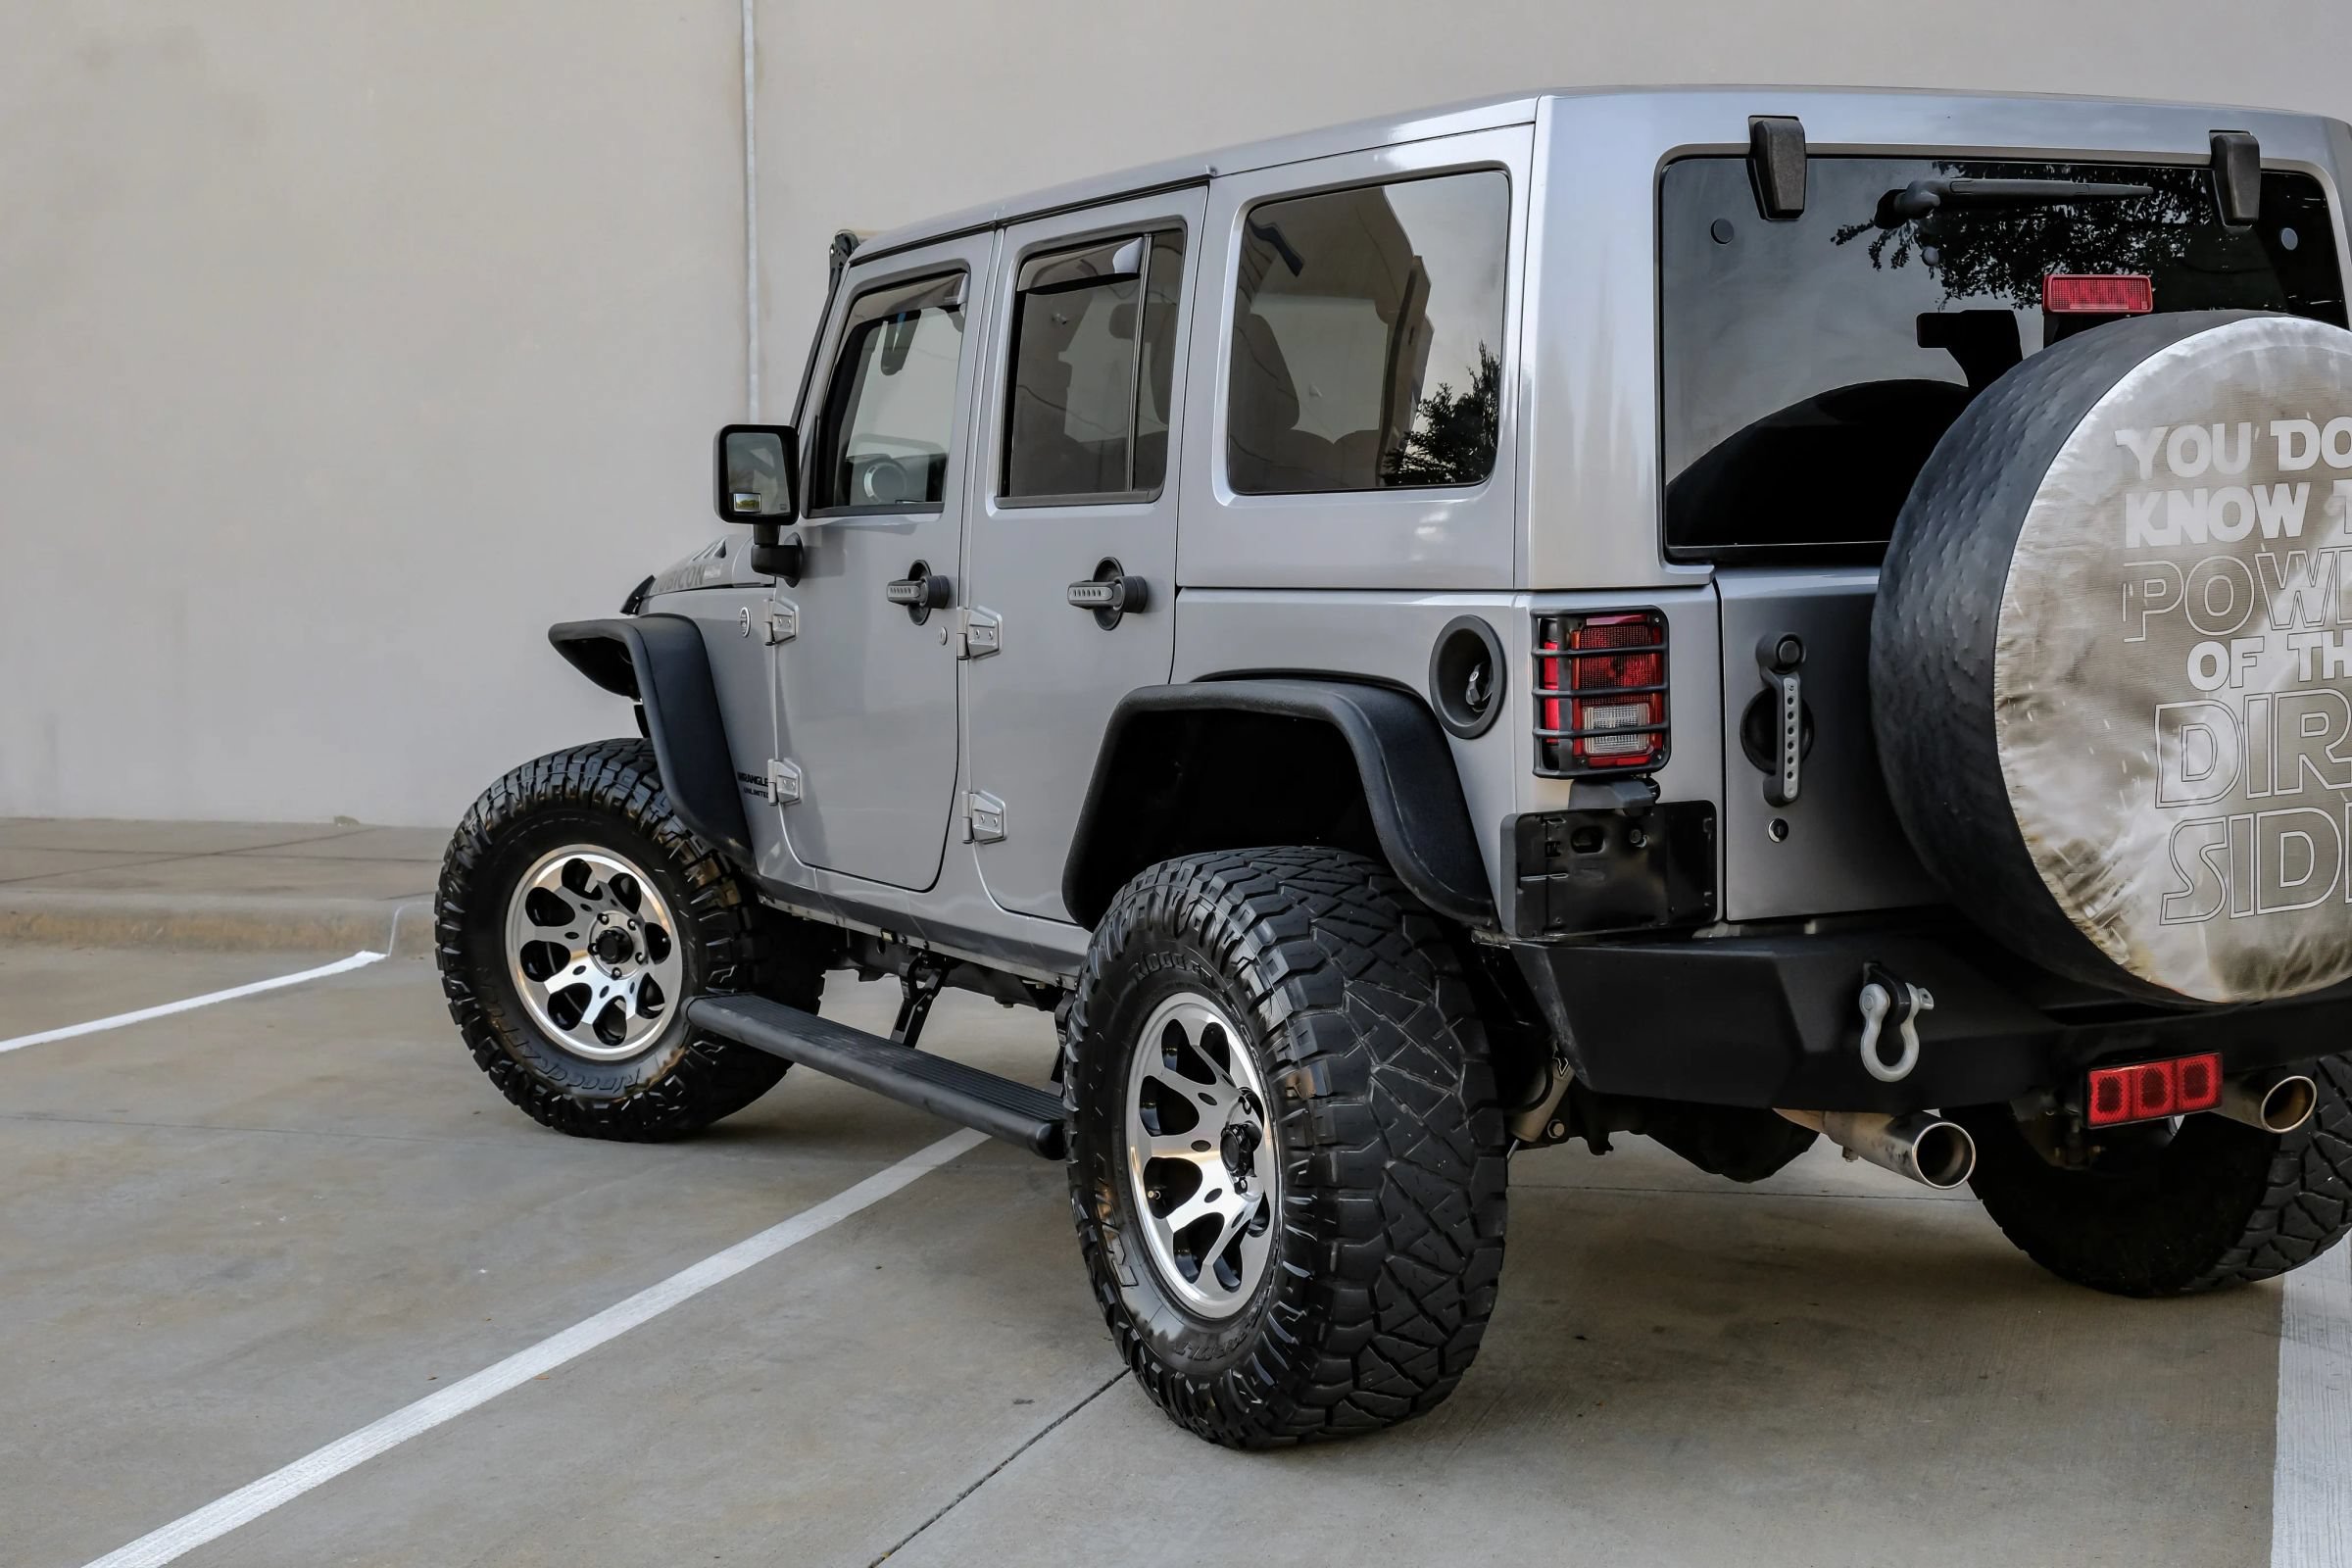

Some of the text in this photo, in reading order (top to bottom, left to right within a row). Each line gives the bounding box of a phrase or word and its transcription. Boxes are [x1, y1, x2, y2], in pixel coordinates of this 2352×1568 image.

[2115, 421, 2252, 480] YOU
[2126, 481, 2311, 549] KNOW
[2186, 628, 2352, 691] OF TH
[737, 771, 769, 788] WRANGLE
[2159, 801, 2352, 926] SID
